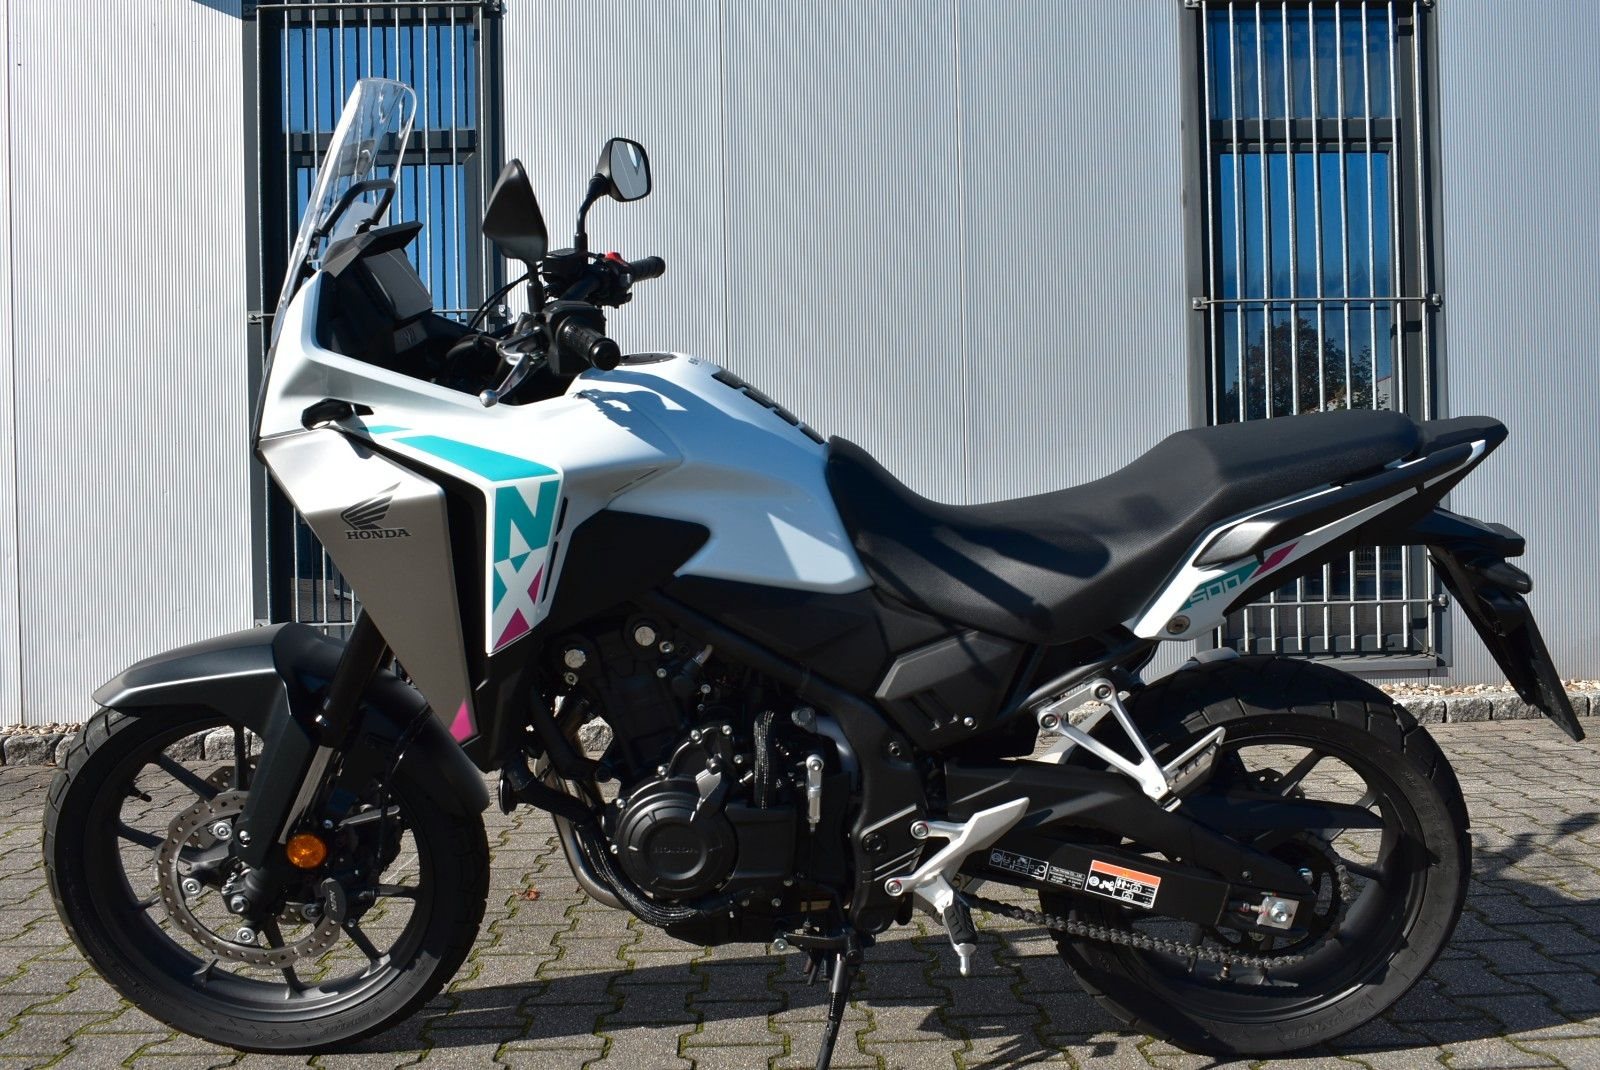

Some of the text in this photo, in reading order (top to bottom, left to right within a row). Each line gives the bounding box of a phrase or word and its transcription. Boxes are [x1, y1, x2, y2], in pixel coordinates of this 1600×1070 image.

[345, 528, 412, 540] HONDA
[493, 480, 560, 650] NX
[1189, 574, 1241, 602] 500
